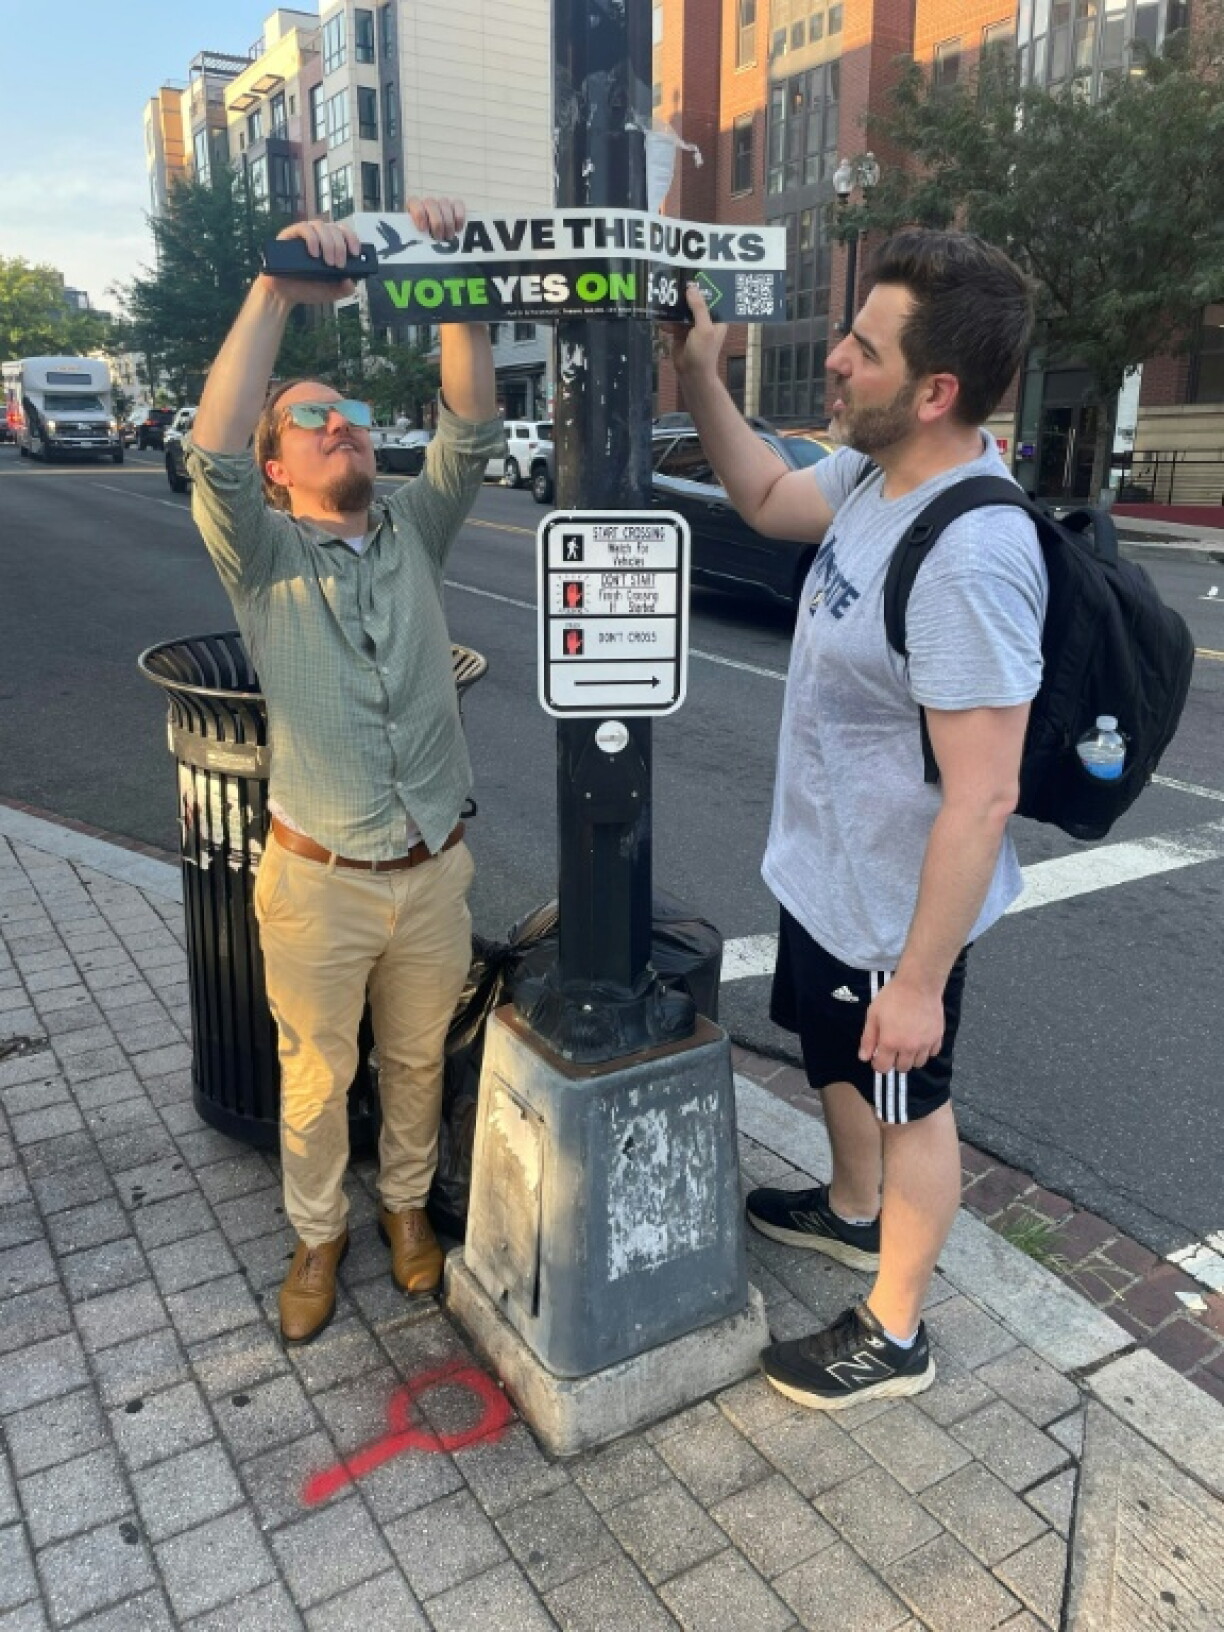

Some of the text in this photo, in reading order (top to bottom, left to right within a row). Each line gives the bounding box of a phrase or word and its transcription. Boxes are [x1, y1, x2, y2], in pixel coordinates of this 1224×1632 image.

[563, 217, 645, 249] THE
[649, 221, 766, 262] DUCKS
[384, 277, 489, 308] VOTE
[491, 274, 570, 303] YES
[576, 272, 636, 302] ON
[593, 527, 665, 538] START CROSSING
[601, 572, 655, 587] DON'T START
[599, 631, 657, 643] DON'T CROSS
